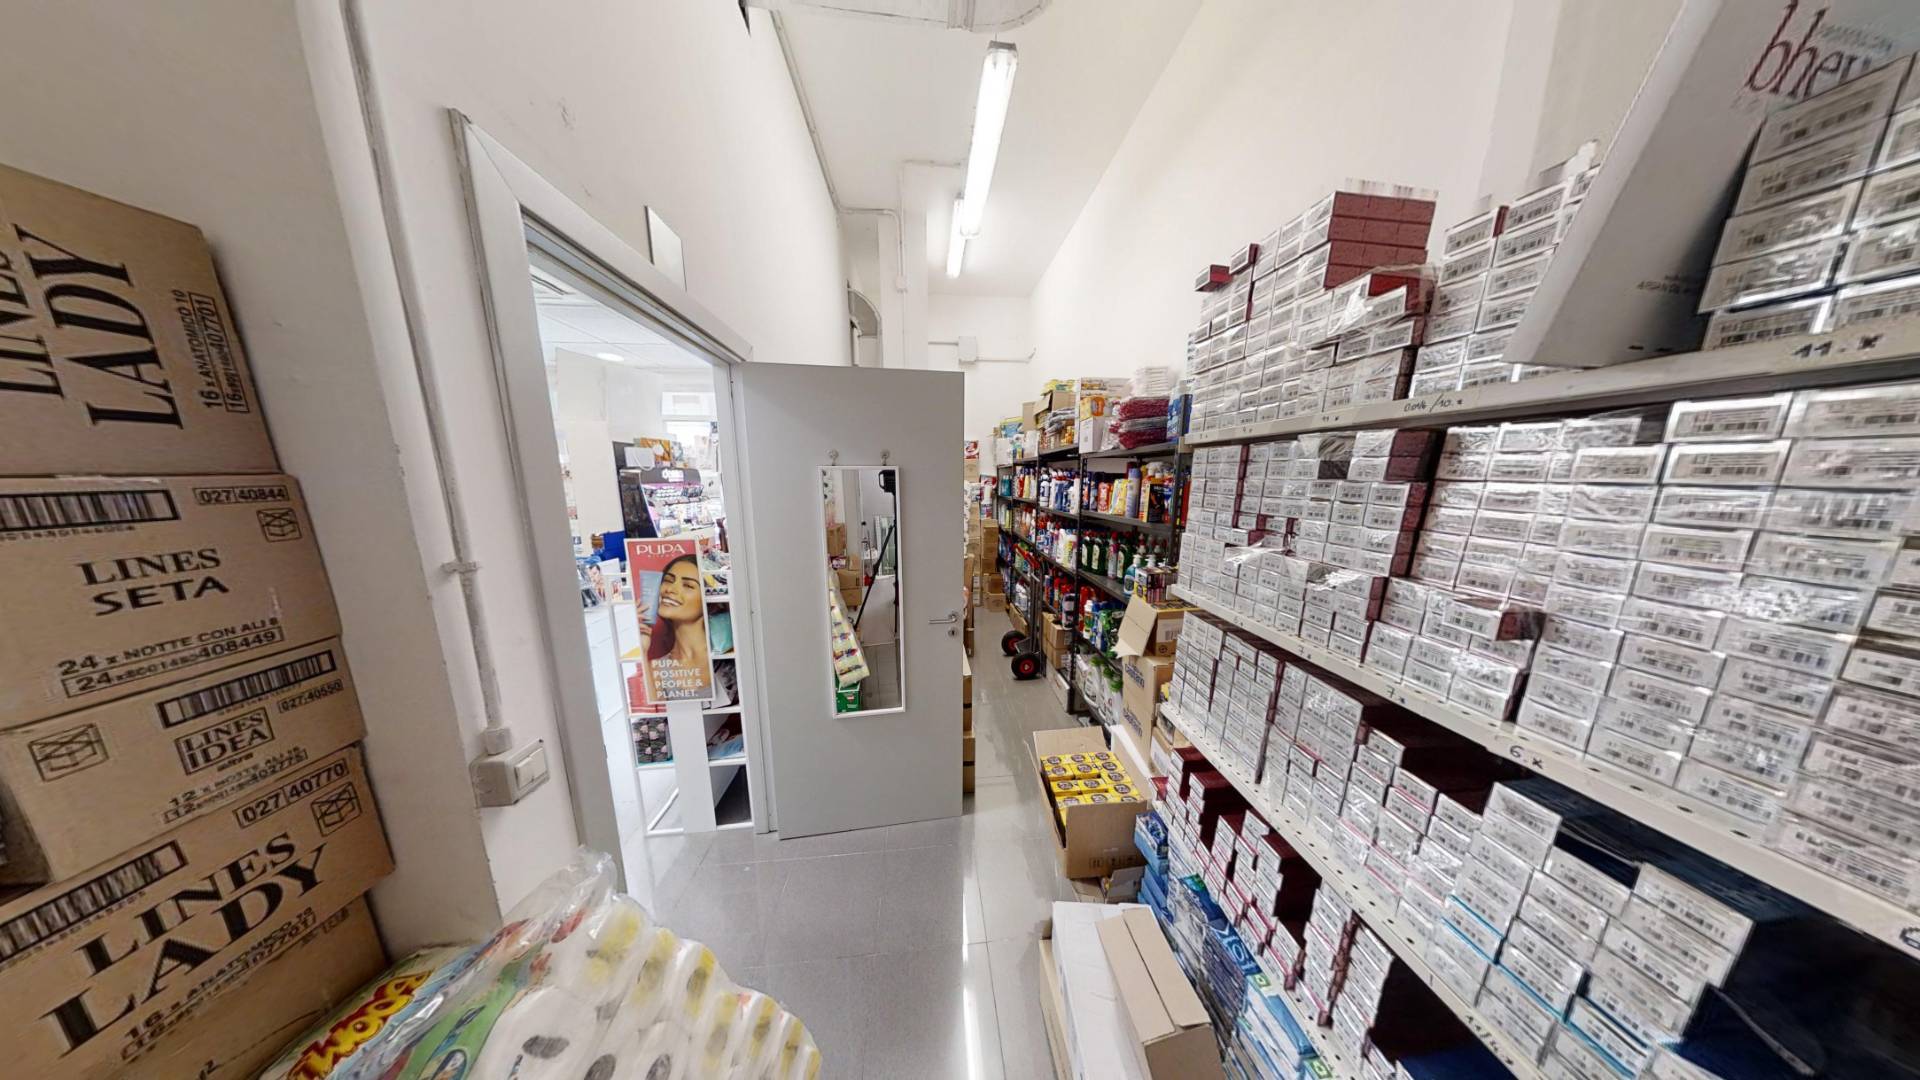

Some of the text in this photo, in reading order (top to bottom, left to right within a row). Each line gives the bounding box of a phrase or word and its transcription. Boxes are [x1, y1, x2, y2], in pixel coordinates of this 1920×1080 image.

[13, 223, 184, 430] LADY
[177, 305, 215, 379] ANATOMICO
[200, 389, 223, 409] 16
[199, 487, 286, 503] 027 40844
[75, 547, 222, 586] LINES
[636, 543, 686, 556] PUPA
[92, 575, 230, 617] SETA
[57, 653, 100, 677] 24
[123, 636, 194, 661] NOTTE
[198, 625, 237, 643] CON
[240, 618, 267, 634] ALI
[653, 667, 702, 679] POSITIVE
[655, 678, 704, 689] PEOPLE &
[281, 697, 305, 713] 027
[182, 712, 264, 754] LINES
[185, 727, 269, 770] IDEA
[242, 762, 346, 823] 027 40770
[74, 832, 296, 979] LINES
[38, 842, 328, 1060] LADY
